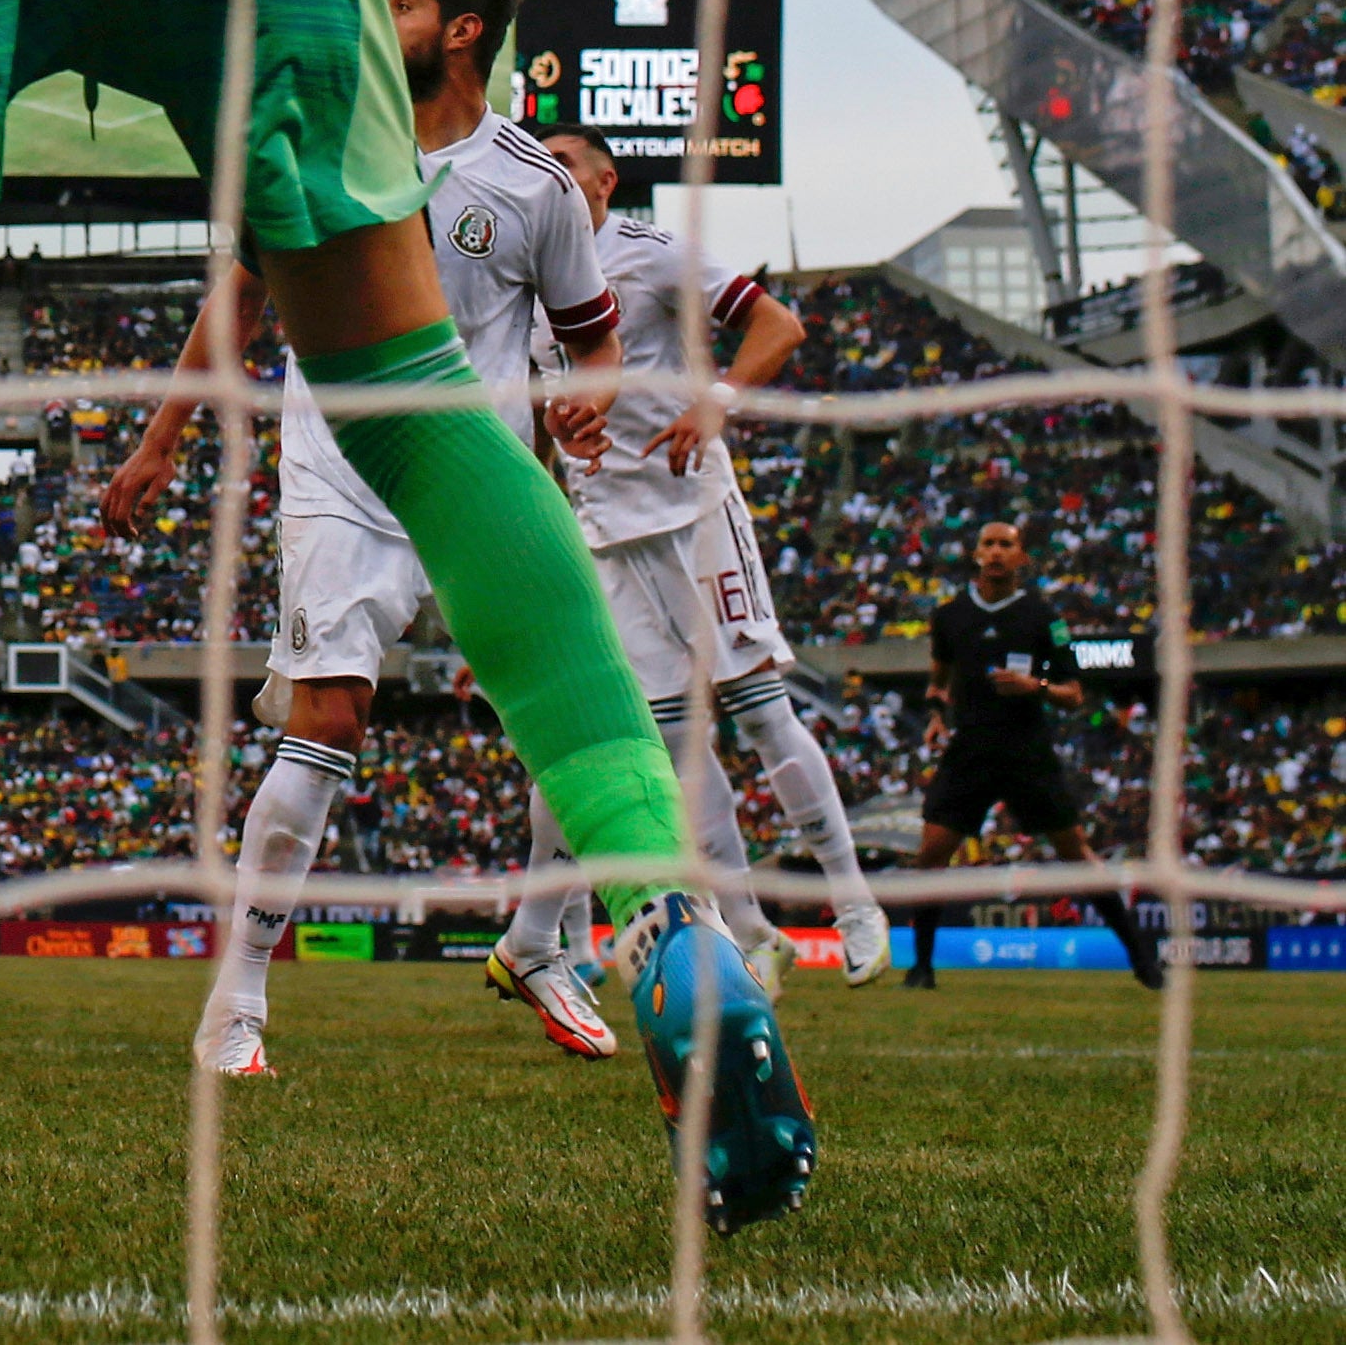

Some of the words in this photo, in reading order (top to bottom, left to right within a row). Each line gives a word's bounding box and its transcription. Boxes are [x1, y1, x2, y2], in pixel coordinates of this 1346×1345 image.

[580, 87, 698, 127] LOCALES
[697, 569, 748, 625] 16
[246, 905, 287, 930] FMF
